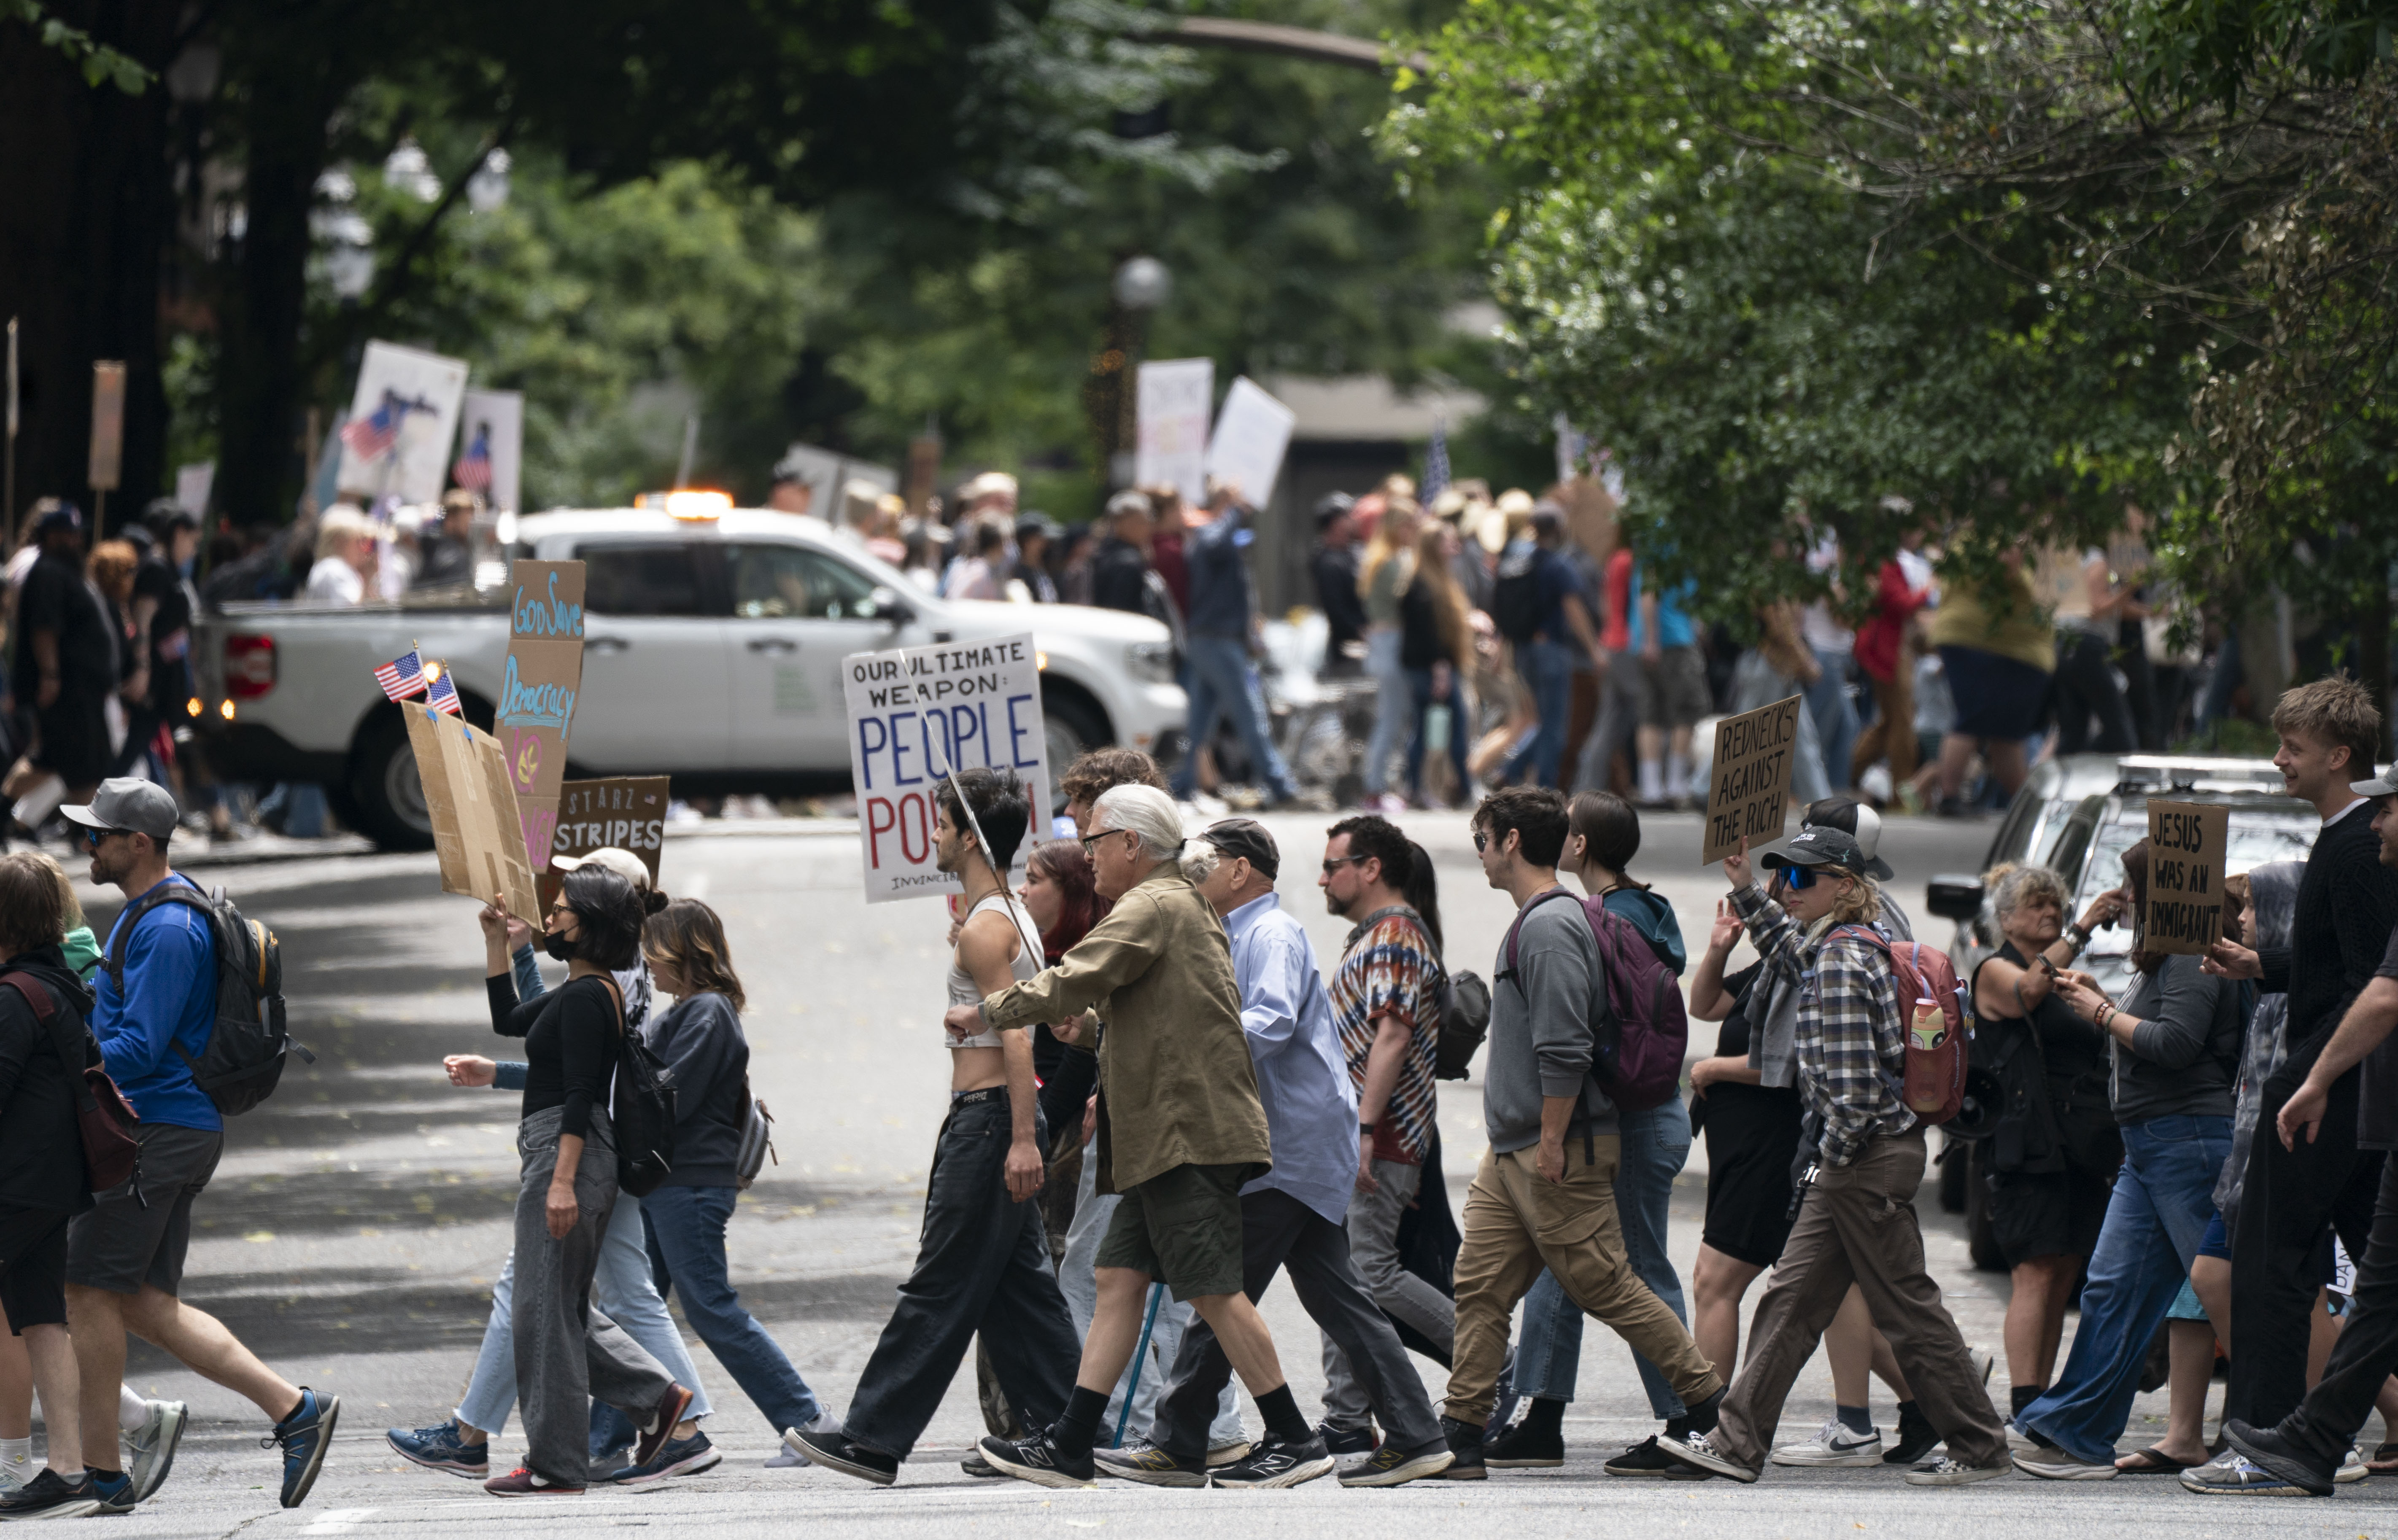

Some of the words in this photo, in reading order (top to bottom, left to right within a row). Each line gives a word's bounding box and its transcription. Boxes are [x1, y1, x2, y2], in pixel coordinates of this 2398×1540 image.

[548, 571, 583, 637] Save
[854, 660, 897, 683] OUR
[904, 642, 1025, 677] ULTIMATE
[498, 654, 575, 741] Democracy
[869, 673, 1008, 708] WEAPON:
[859, 694, 1039, 789] PEOPLE
[1722, 701, 1795, 764] REDNECKS
[1717, 750, 1785, 807] AGAINST
[568, 786, 634, 815] STARZ
[1713, 809, 1741, 847] THE
[1745, 792, 1781, 836] RICH
[553, 820, 663, 851] STRIPES
[2154, 813, 2202, 853] JESUS
[891, 872, 960, 890] INVINCIB
[2155, 859, 2184, 891] WAS
[2189, 864, 2208, 894] AN
[2151, 901, 2220, 945] IMMIGRANT
